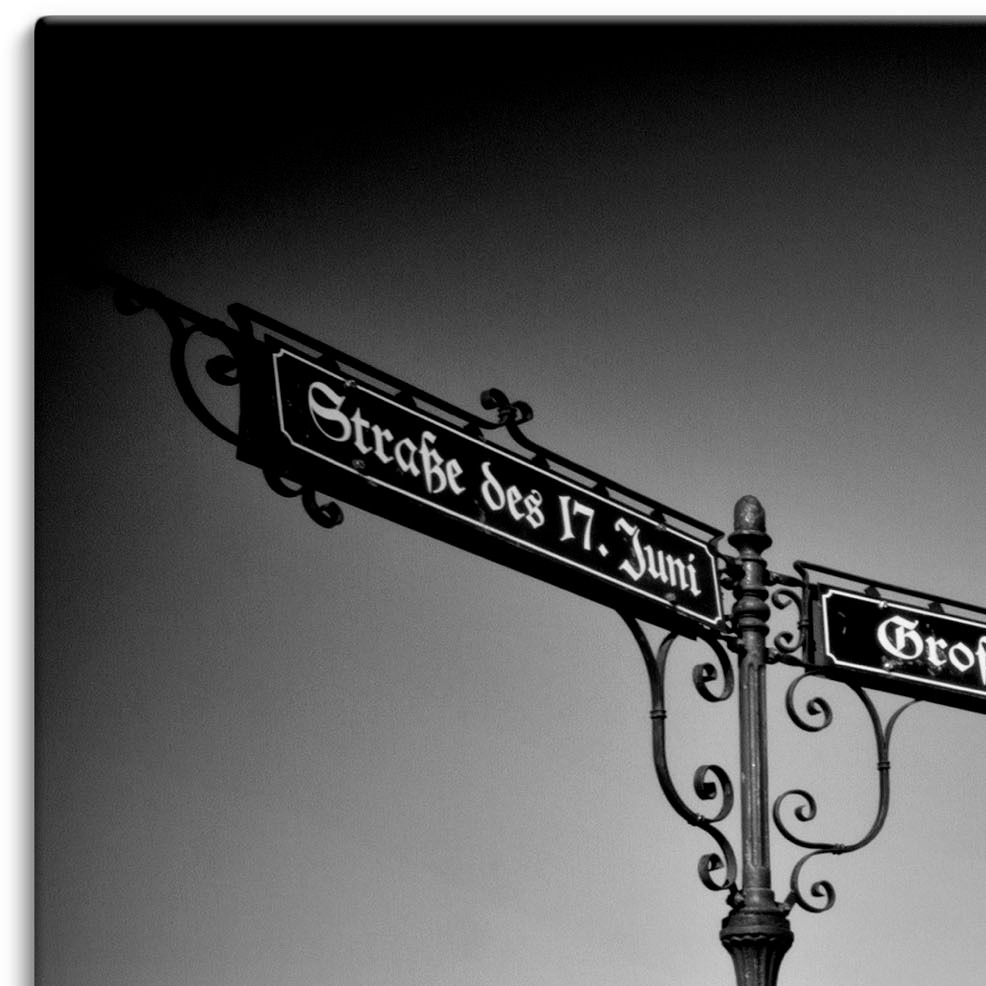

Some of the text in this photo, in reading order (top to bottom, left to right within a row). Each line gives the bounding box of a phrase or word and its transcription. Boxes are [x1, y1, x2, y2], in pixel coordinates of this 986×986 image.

[308, 381, 702, 597] Straße des 17. Juni
